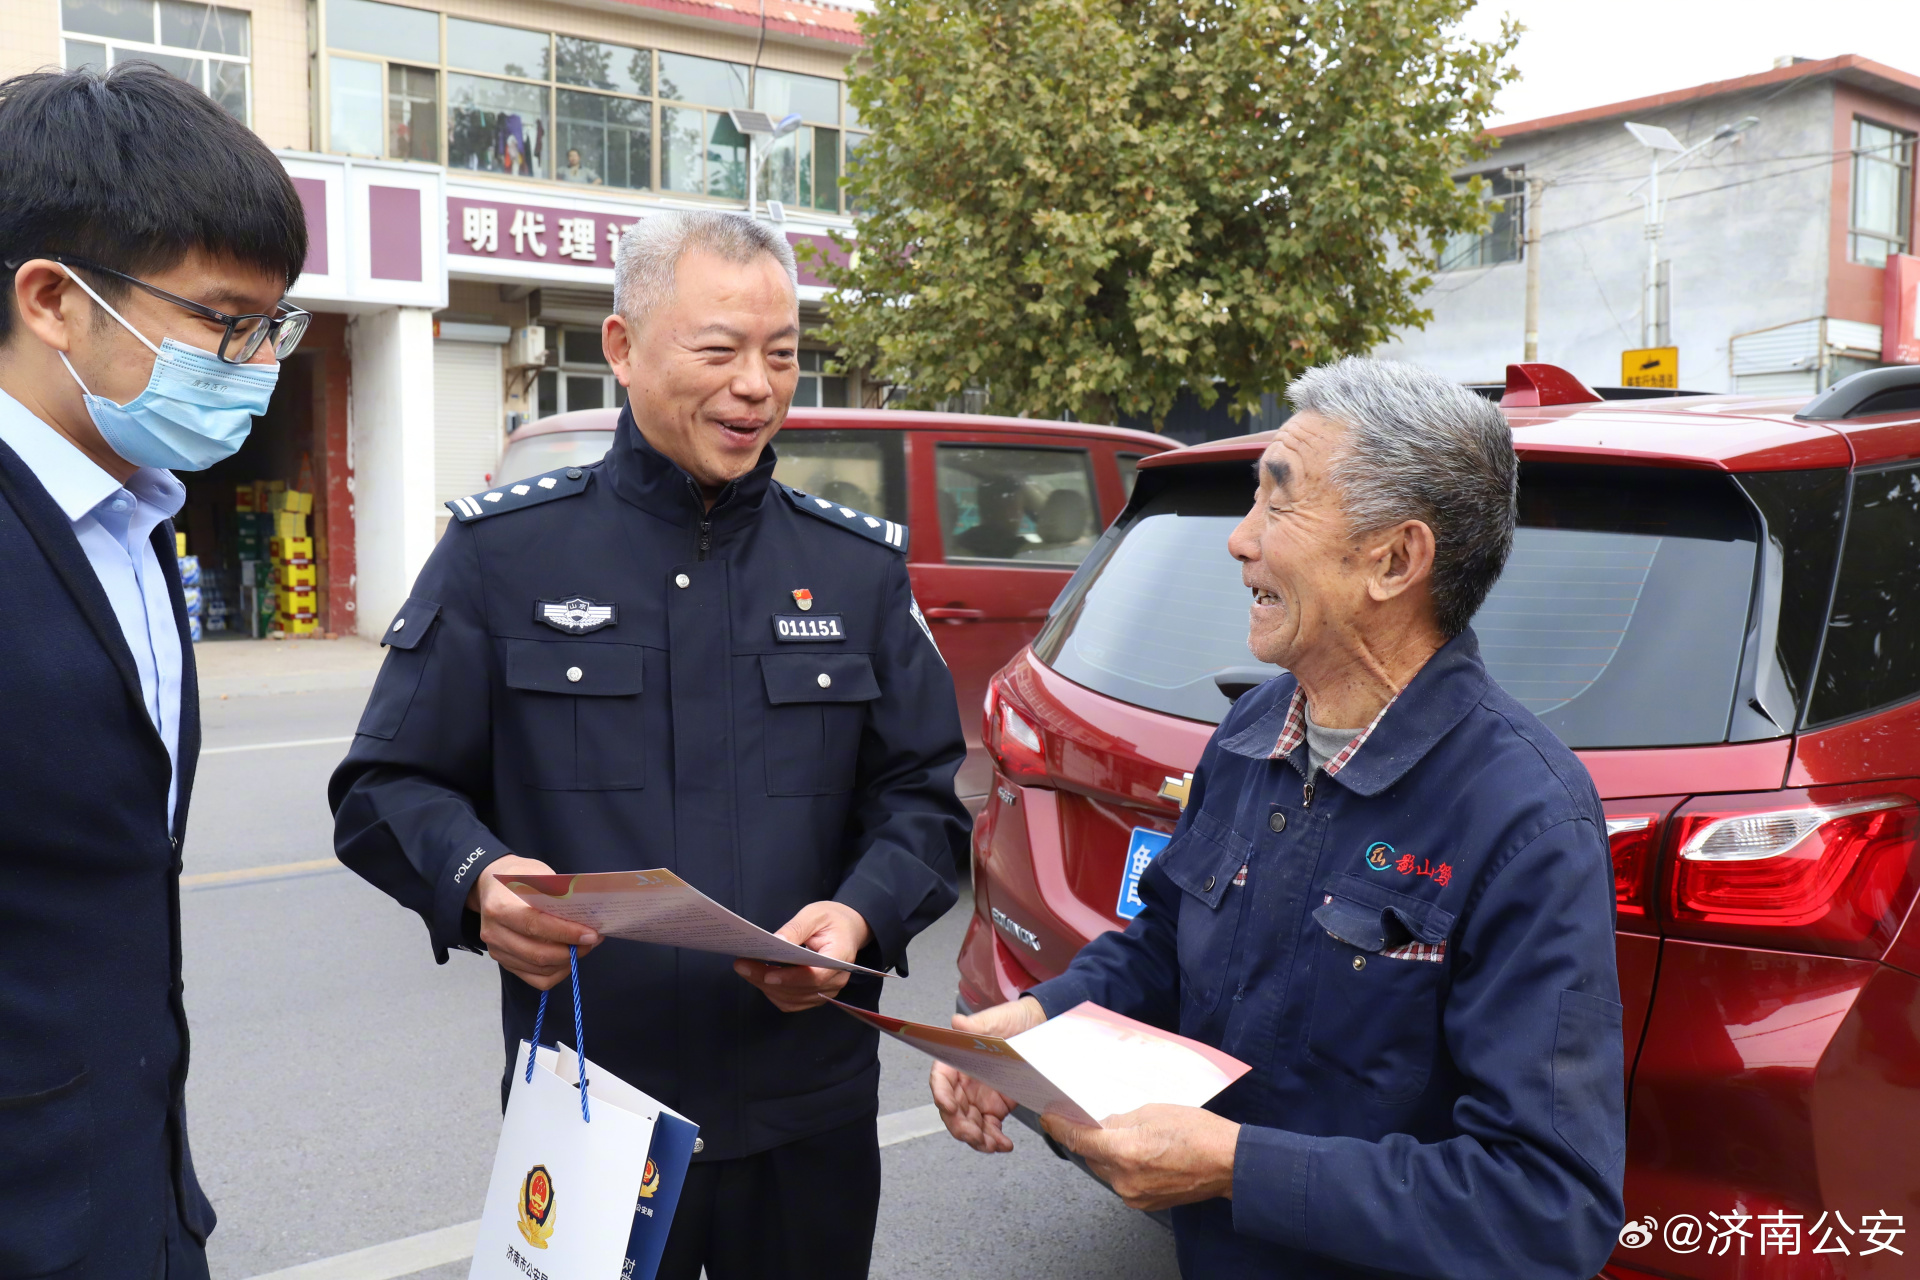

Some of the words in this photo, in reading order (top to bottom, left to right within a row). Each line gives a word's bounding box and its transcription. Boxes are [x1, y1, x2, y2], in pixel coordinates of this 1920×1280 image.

[447, 206, 634, 263] 明代理
[778, 619, 841, 636] 011151
[453, 846, 487, 884] POLICE
